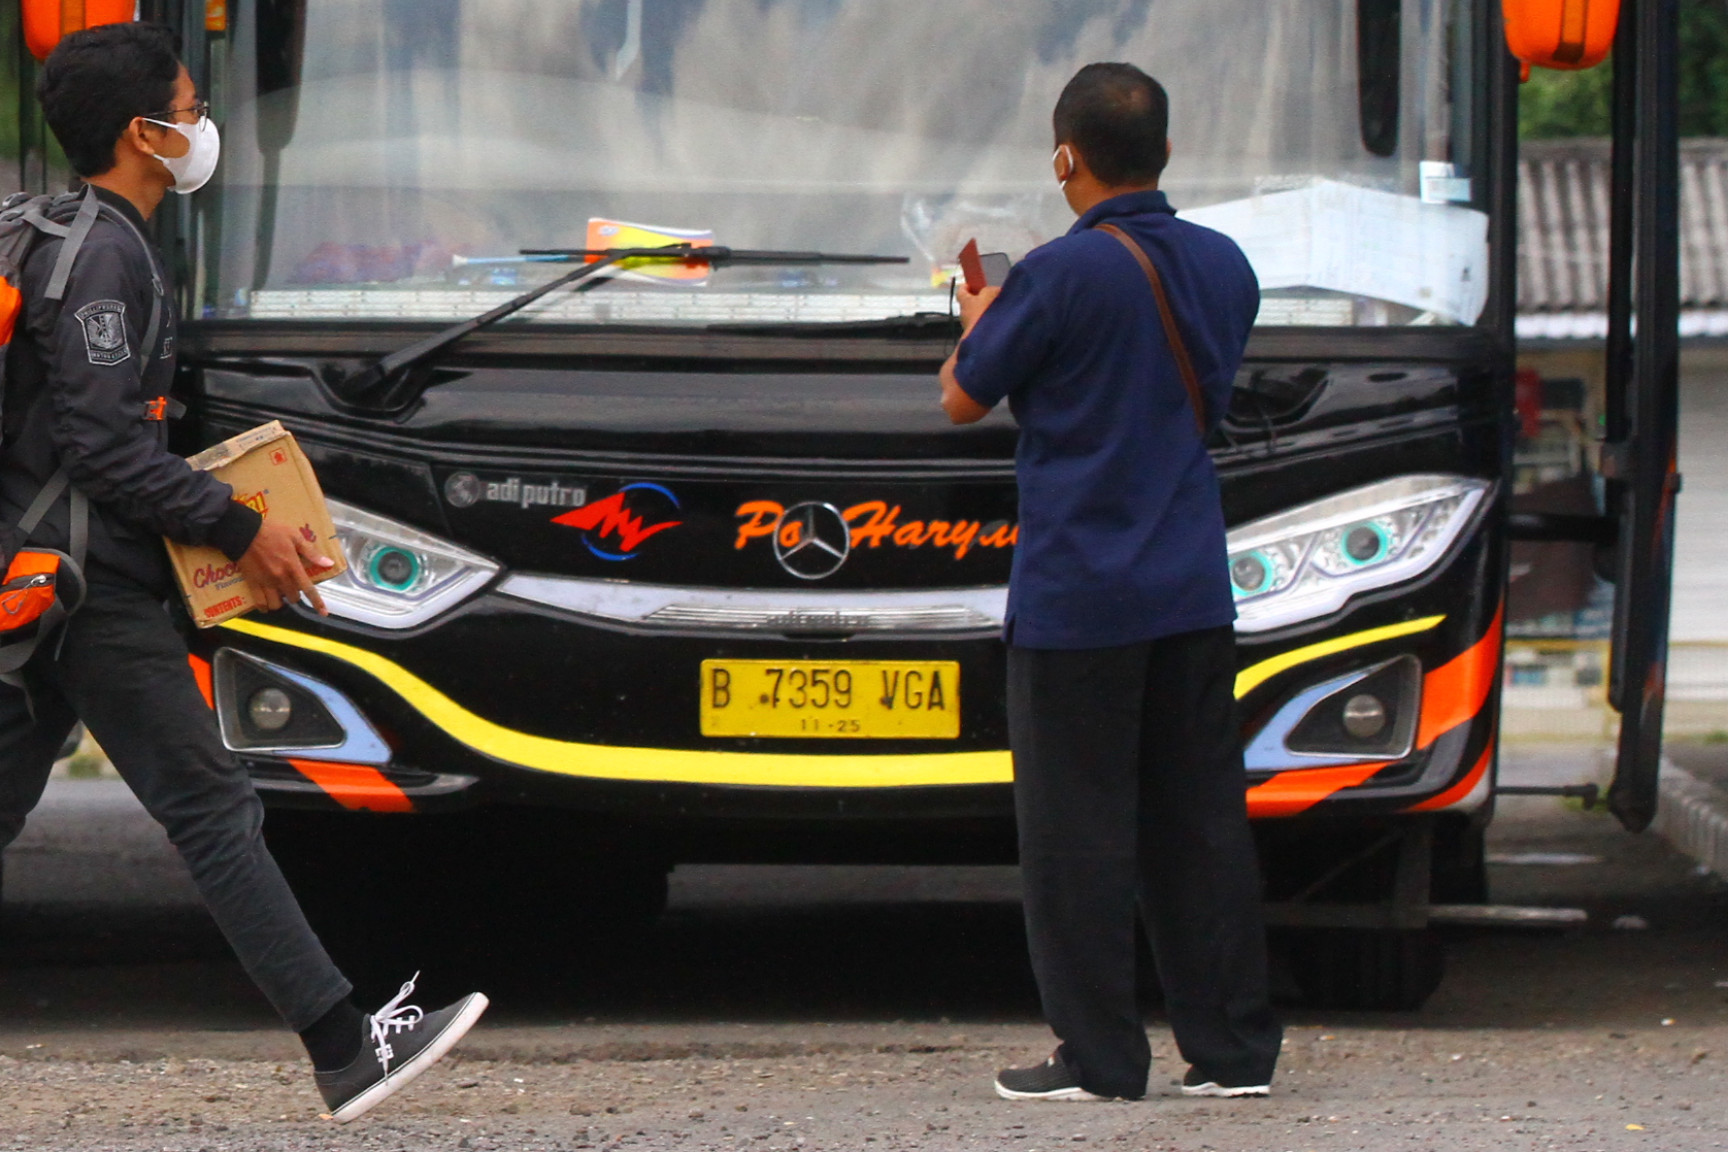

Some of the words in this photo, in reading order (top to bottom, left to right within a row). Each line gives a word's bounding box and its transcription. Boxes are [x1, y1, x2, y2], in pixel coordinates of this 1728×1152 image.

[712, 668, 731, 708] B
[765, 669, 853, 708] 7359
[881, 670, 945, 710] VGA
